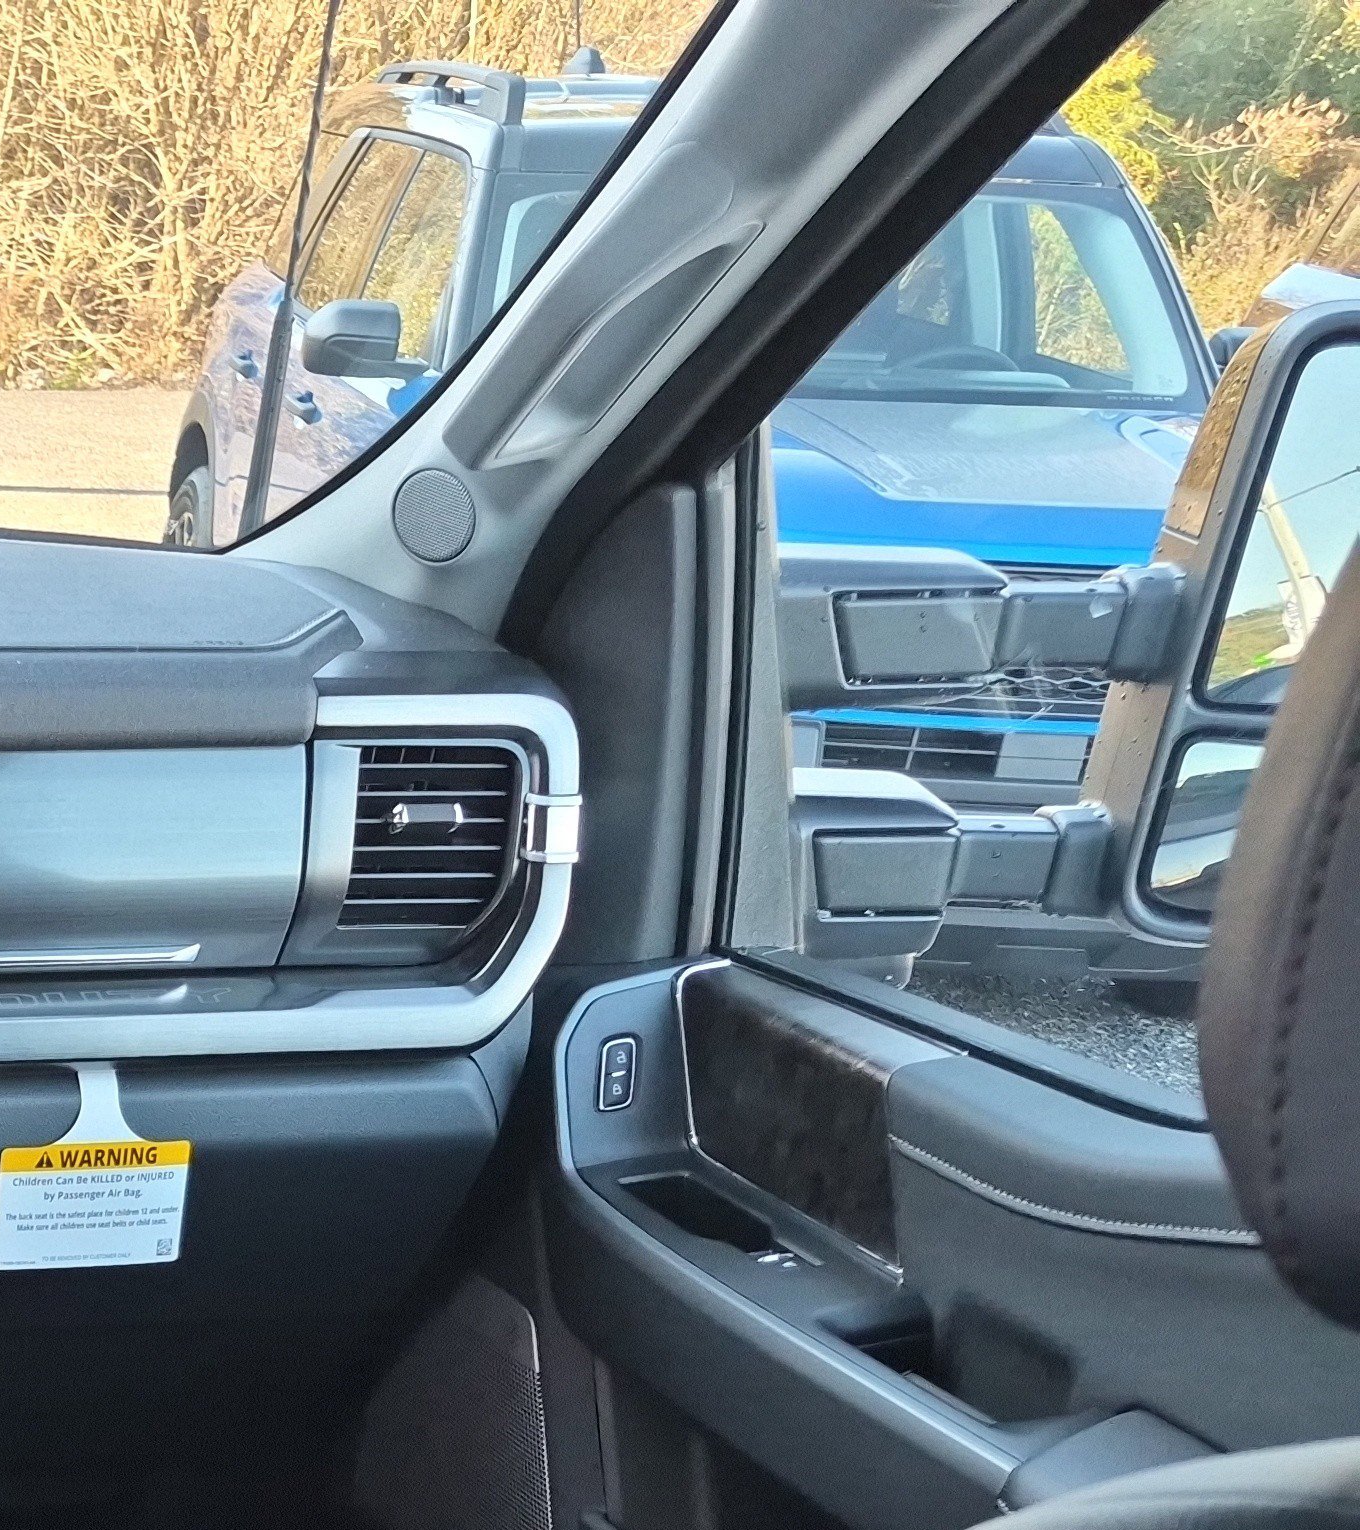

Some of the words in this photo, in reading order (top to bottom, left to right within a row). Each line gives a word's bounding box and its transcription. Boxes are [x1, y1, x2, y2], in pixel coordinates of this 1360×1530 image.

[59, 1146, 158, 1168] WARNING
[12, 1177, 53, 1187] Children
[56, 1176, 74, 1185] Can
[76, 1175, 88, 1185] Be
[91, 1174, 123, 1184] KILLED
[125, 1175, 135, 1183] or
[137, 1171, 175, 1183] INJURED
[43, 1191, 55, 1202] by
[57, 1191, 105, 1201] Passenger
[107, 1189, 122, 1198] Air
[55, 1211, 66, 1219] the
[104, 1209, 113, 1217] for
[115, 1208, 139, 1216] children
[141, 1207, 148, 1215] 12
[149, 1207, 160, 1215] and
[59, 1222, 85, 1230] children
